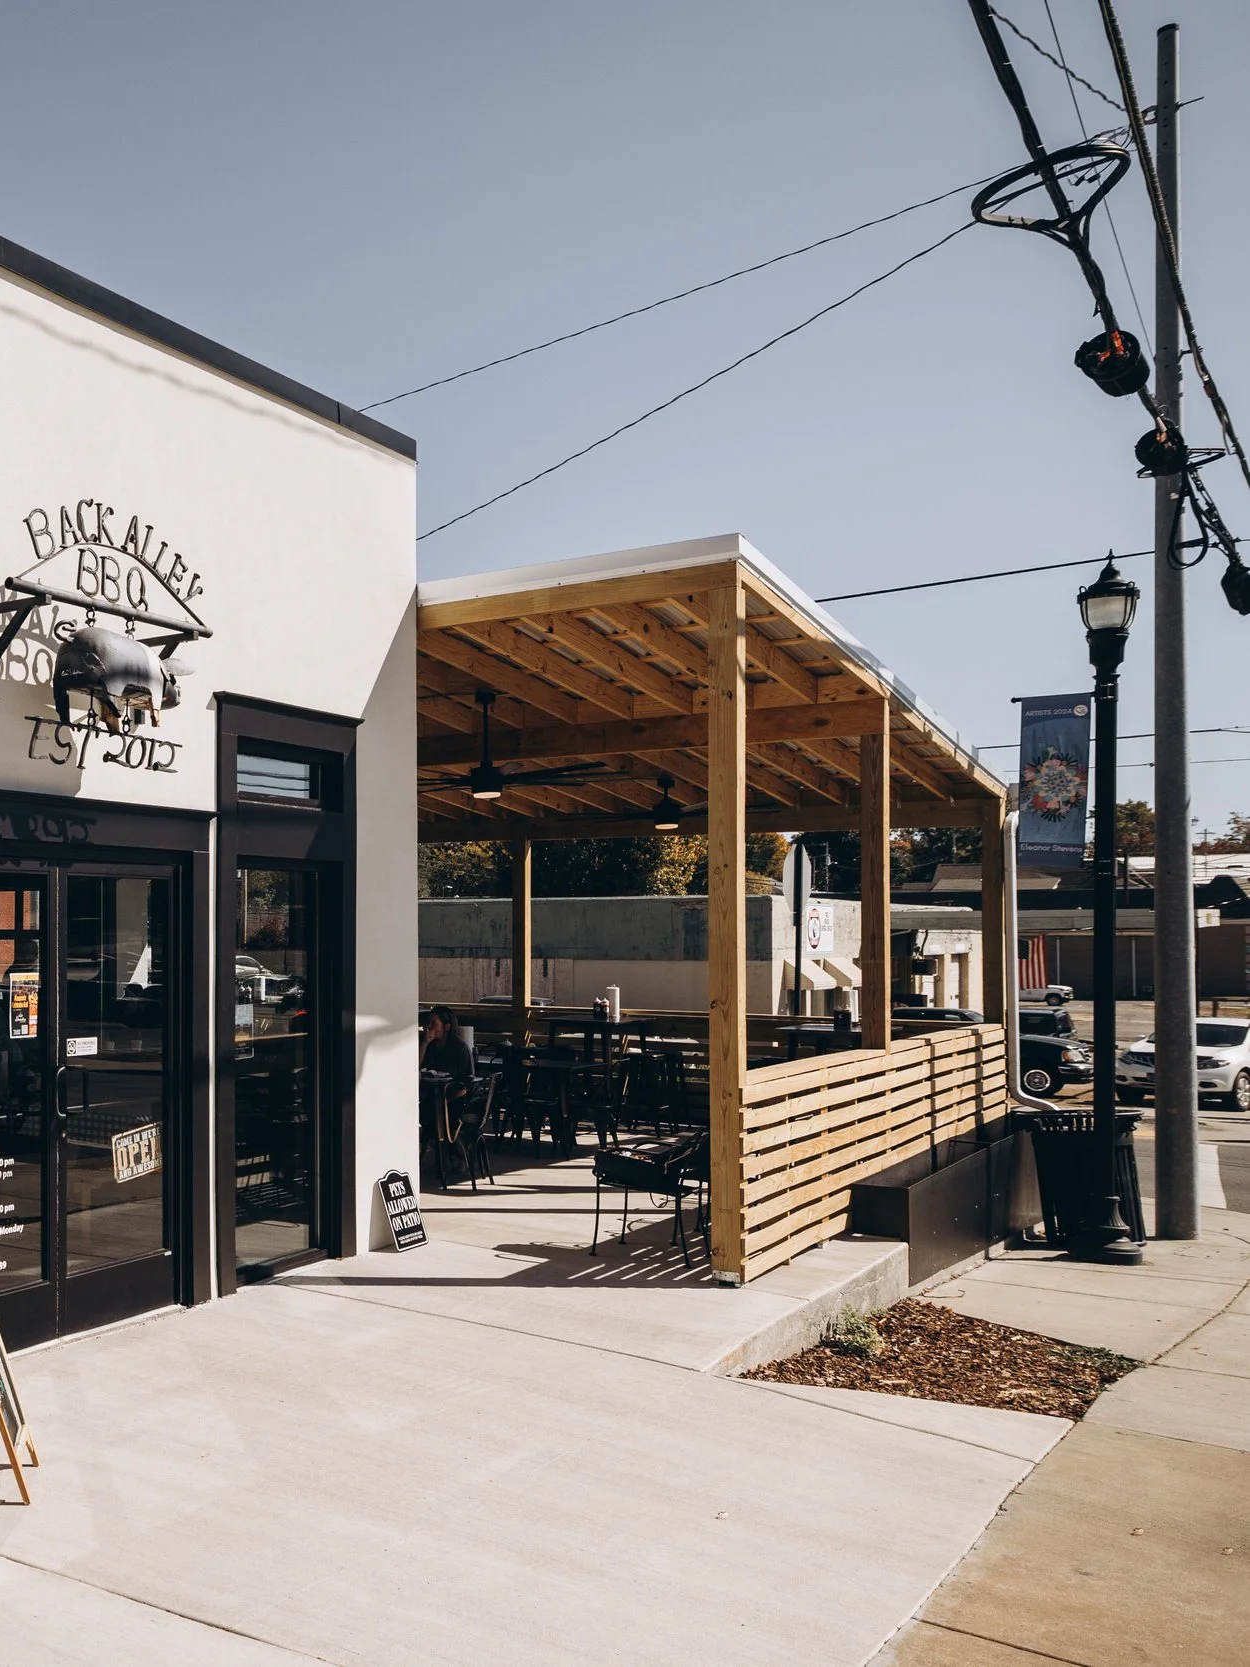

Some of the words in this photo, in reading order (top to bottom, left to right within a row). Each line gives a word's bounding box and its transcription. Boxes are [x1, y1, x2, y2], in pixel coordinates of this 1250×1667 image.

[22, 498, 114, 560] BACK
[120, 515, 204, 602] ALLEY
[76, 547, 149, 612] BBQ
[1025, 709, 1052, 717] ARTISTS
[27, 717, 100, 770] EST
[103, 733, 179, 774] 2012
[1020, 843, 1051, 851] Eleanor
[1052, 845, 1083, 853] Stevens
[116, 1135, 133, 1148] COME
[133, 1133, 141, 1143] IN
[116, 1136, 161, 1171] OPEN
[4, 1157, 15, 1168] pm
[2, 1170, 13, 1180] pm
[119, 1167, 132, 1180] AND
[388, 1180, 406, 1198] PETS
[4, 1203, 15, 1214] pm
[387, 1195, 417, 1216] ALLOWED
[392, 1214, 404, 1232] ON
[401, 1211, 421, 1229] PATIO
[0, 1223, 24, 1236] Monday
